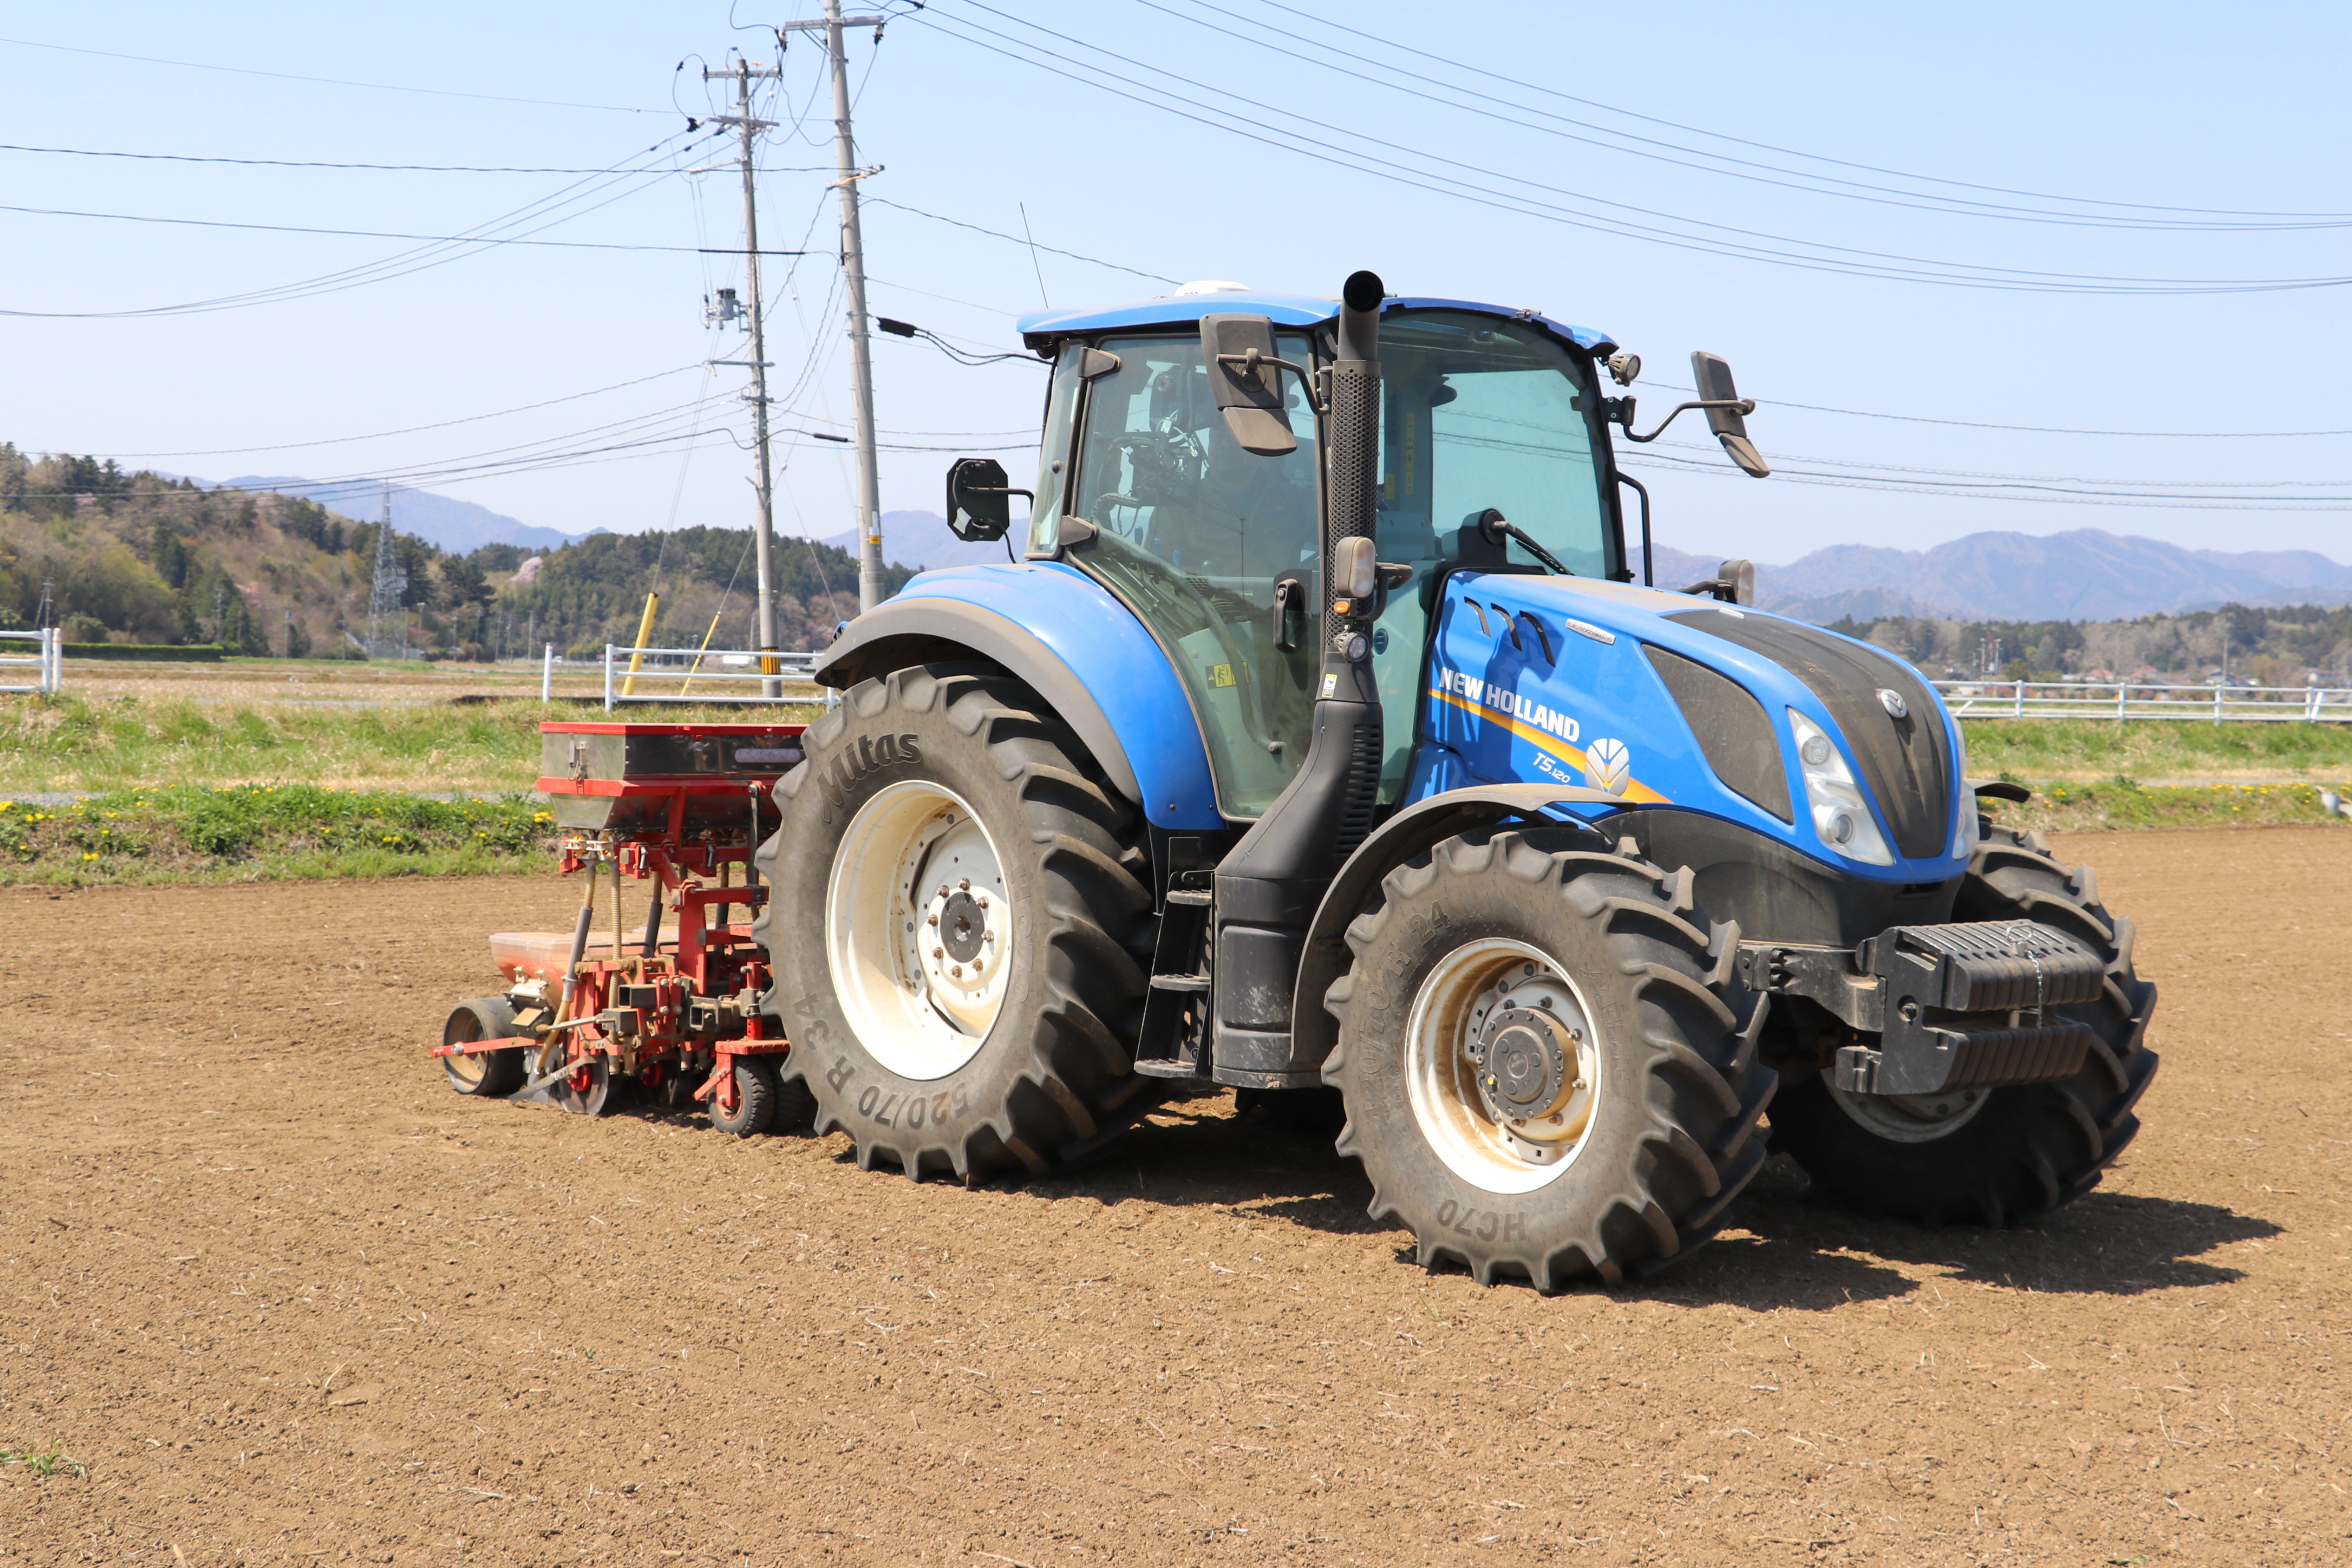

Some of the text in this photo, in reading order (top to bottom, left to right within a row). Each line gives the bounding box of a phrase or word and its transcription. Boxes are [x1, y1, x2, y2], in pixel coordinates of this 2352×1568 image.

[1439, 667, 1580, 742] NEW HOLLAND
[817, 733, 921, 824] Mitas
[1533, 753, 1571, 783] T5.120
[1379, 943, 1411, 977] R
[1409, 900, 1451, 946] 24
[794, 992, 970, 1130] 520/70 R 34
[1437, 1199, 1527, 1242] HC70
